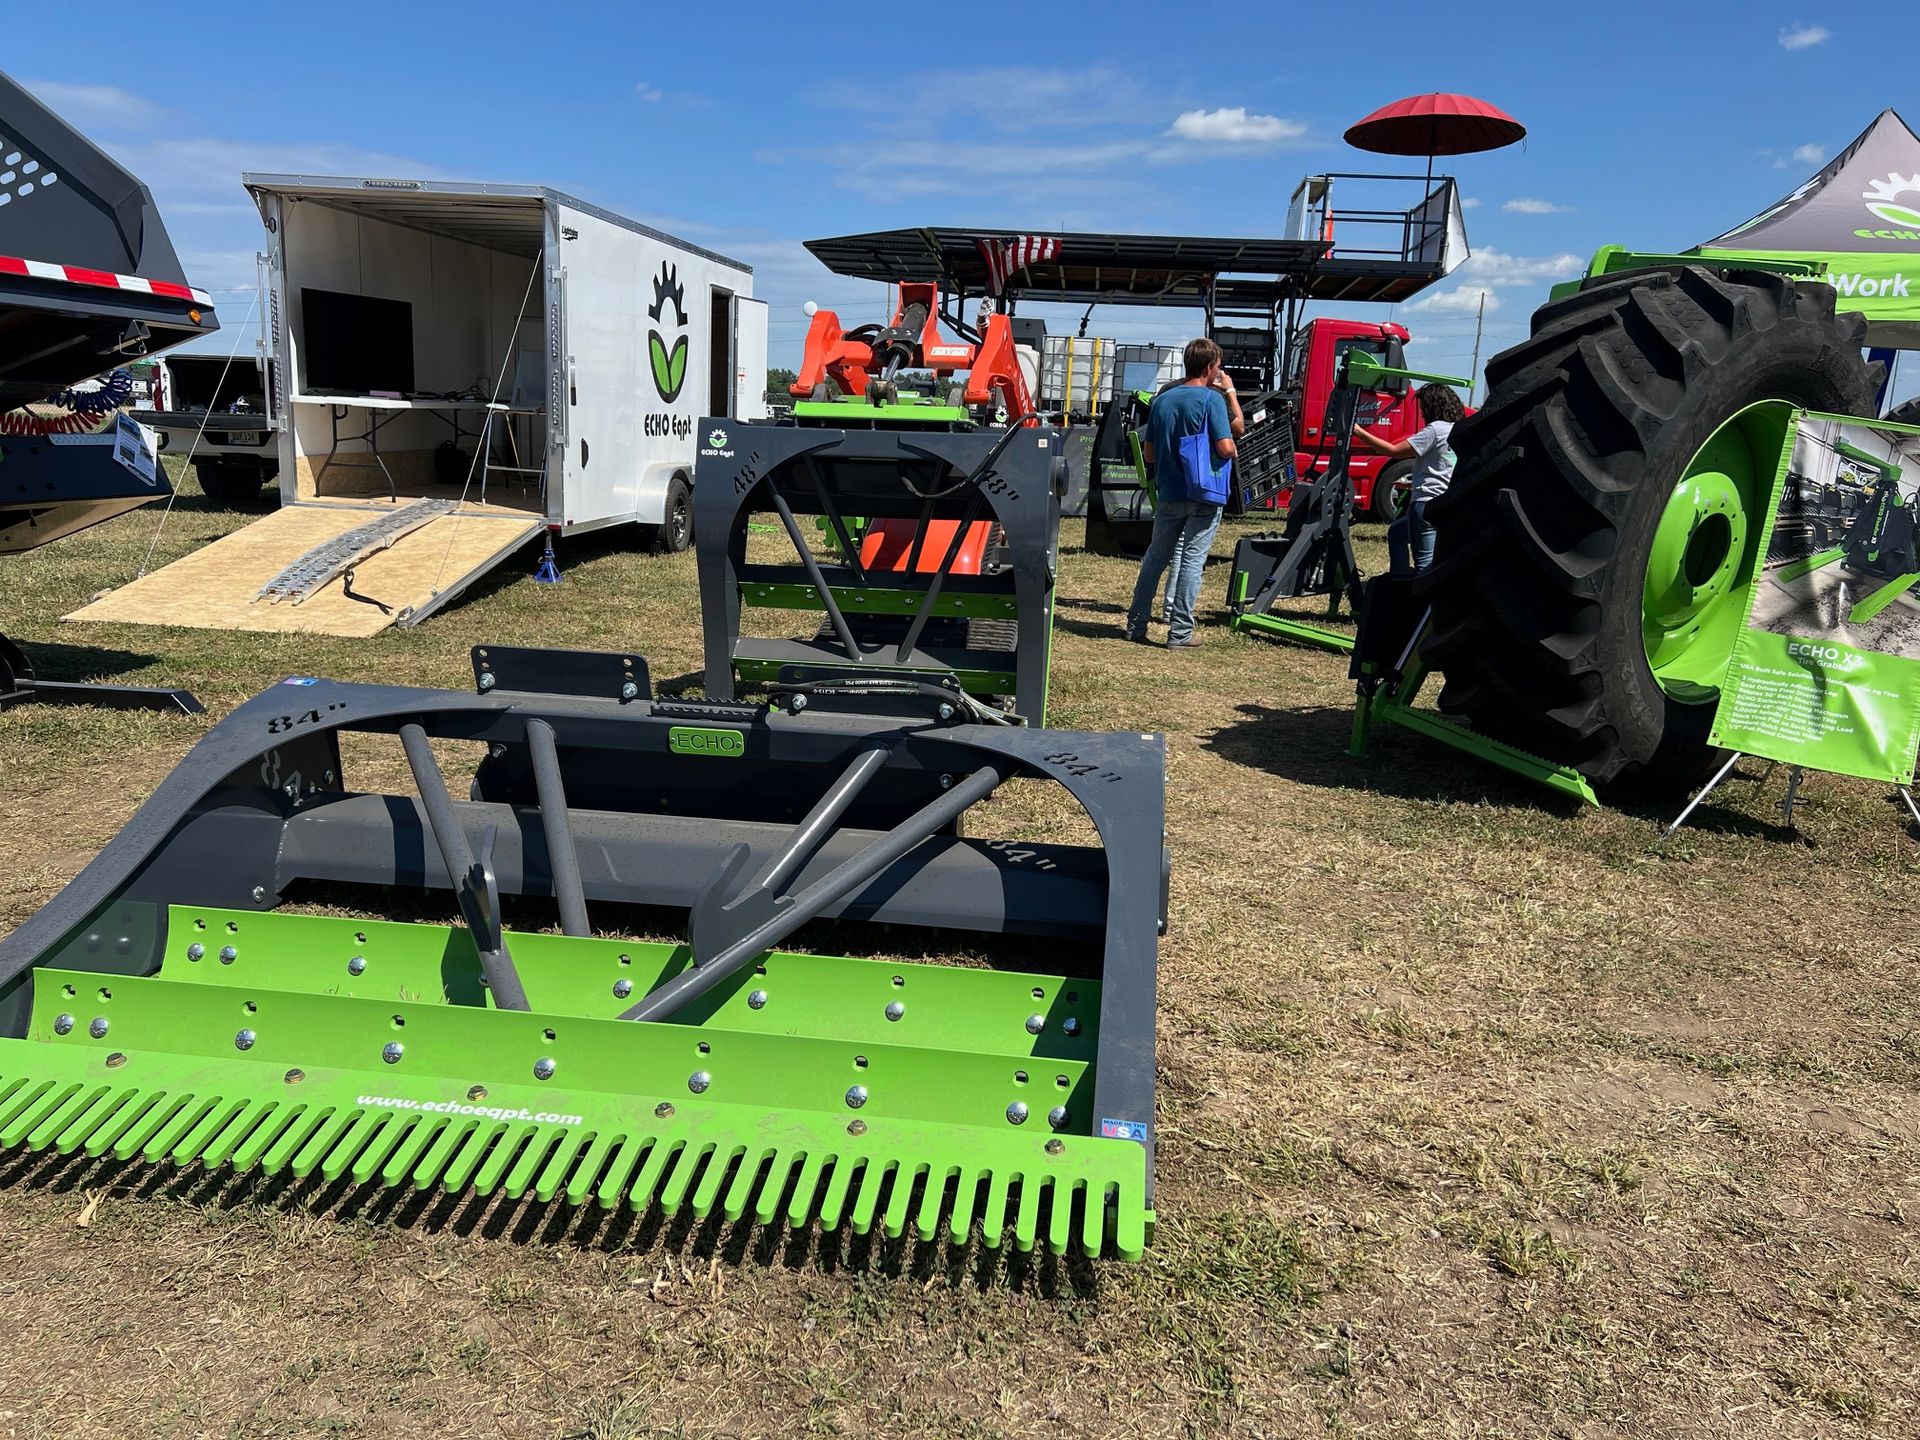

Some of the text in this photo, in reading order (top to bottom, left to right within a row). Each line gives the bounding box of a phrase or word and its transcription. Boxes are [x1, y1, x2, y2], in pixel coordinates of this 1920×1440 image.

[1853, 229, 1920, 240] ECH
[1827, 273, 1911, 297] Work
[644, 414, 692, 441] ECHO Eqpt
[719, 450, 735, 458] Eqpt
[732, 449, 761, 496] 48"
[1109, 471, 1139, 479] Warrant
[981, 469, 1021, 501] 48"
[1788, 643, 1864, 666] ECHO X3
[1798, 657, 1814, 666] Tire
[1747, 676, 1788, 687] Hydraulically
[1790, 683, 1823, 693] Adjustable
[1796, 691, 1821, 700] Diverter
[1883, 690, 1899, 698] Tires
[1794, 697, 1823, 707] Direction
[267, 702, 347, 734] 84"
[1735, 700, 1760, 708] Handles
[1791, 710, 1820, 720] Diameter
[1822, 716, 1837, 724] Tires
[1814, 708, 1848, 719] Mechanism
[1760, 722, 1779, 730] Quick
[1790, 722, 1806, 730] Each
[1807, 727, 1825, 736] Other
[1807, 721, 1835, 731] Working
[676, 733, 736, 752] ECHO
[1043, 752, 1122, 783] 84"
[357, 1095, 583, 1125] www.echoeqpt.com
[1103, 1125, 1145, 1139] USA
